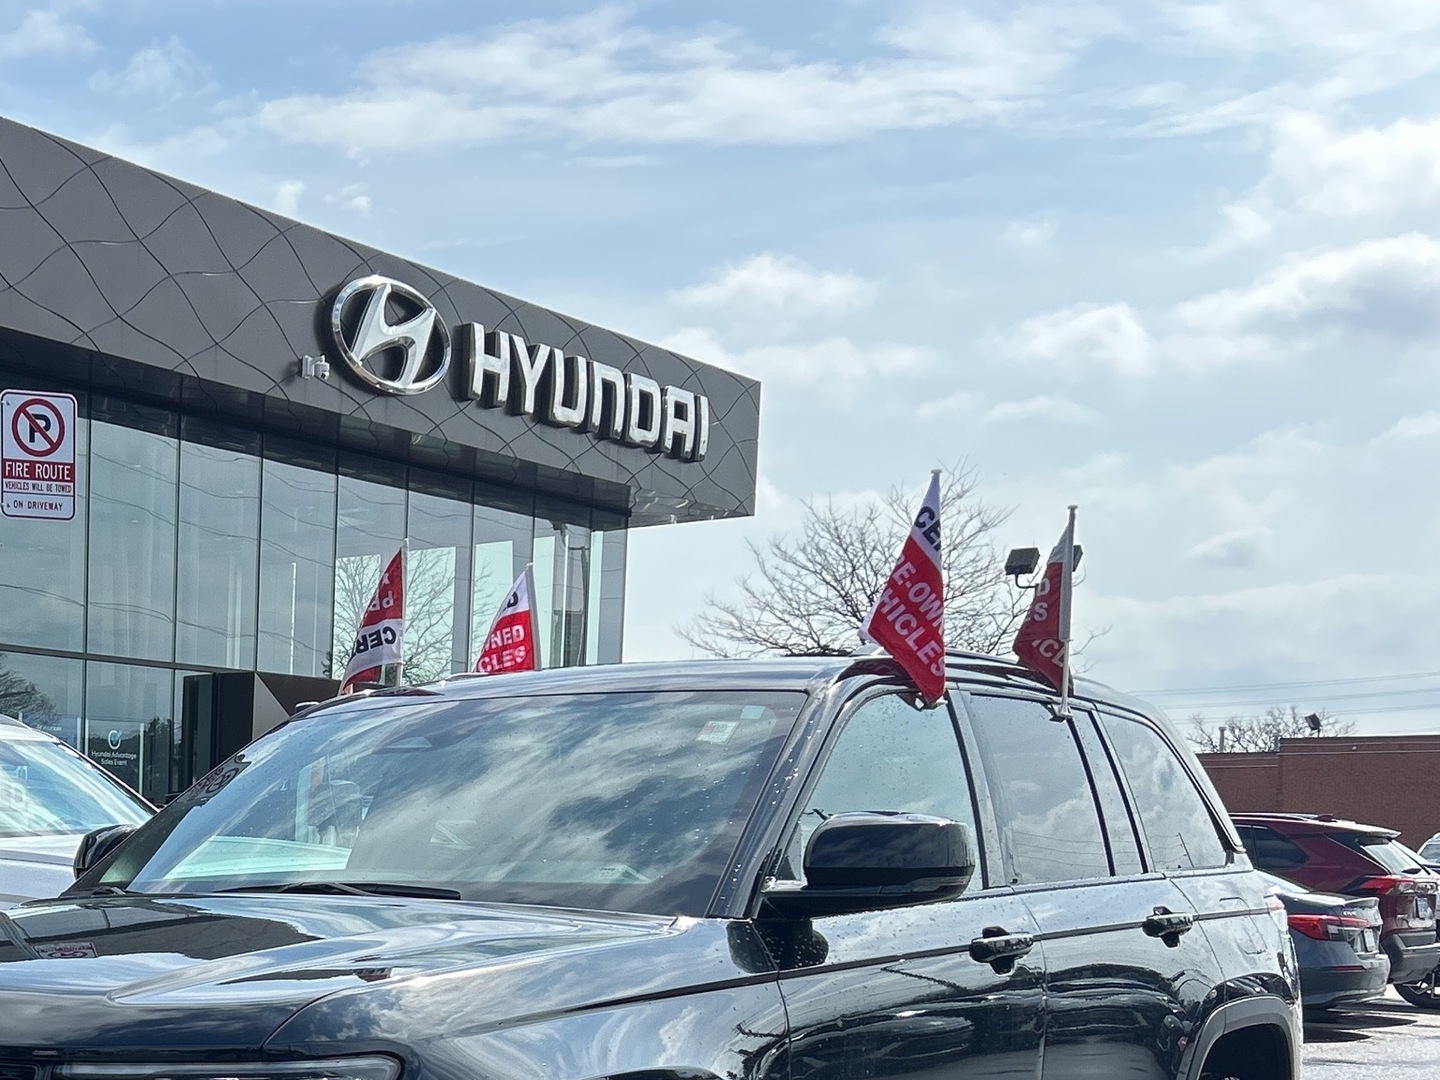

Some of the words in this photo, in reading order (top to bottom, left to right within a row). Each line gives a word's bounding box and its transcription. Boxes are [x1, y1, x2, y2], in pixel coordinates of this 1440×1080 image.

[466, 322, 710, 462] HYUNDAI
[6, 461, 30, 478] FIRE
[35, 463, 71, 480] ROUTE
[5, 481, 29, 491] VEHICLES
[32, 483, 44, 492] WILL
[46, 483, 53, 493] BE
[55, 484, 72, 494] TOWED
[13, 500, 24, 509] ON
[27, 501, 63, 511] DRIVEWAY
[914, 506, 942, 551] CE
[352, 626, 397, 656] CER
[91, 750, 111, 758] Hyundai
[111, 751, 137, 760] Advantage
